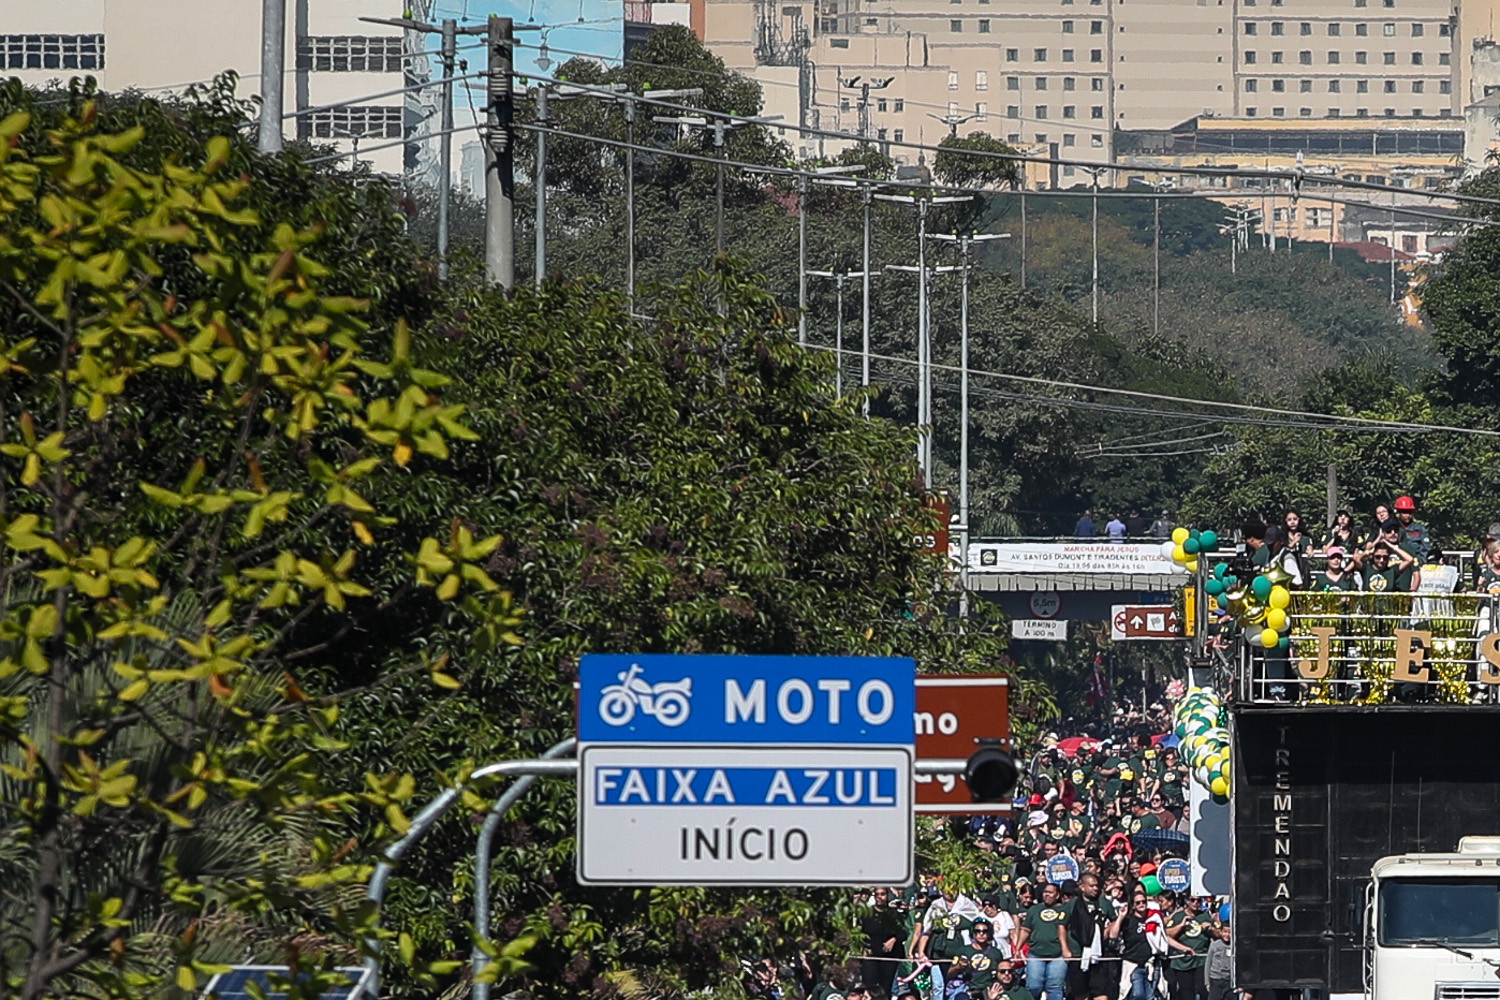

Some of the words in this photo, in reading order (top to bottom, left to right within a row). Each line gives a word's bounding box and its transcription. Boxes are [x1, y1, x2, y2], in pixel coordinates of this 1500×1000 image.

[724, 678, 895, 726] MOTO
[597, 769, 735, 803] FAIXA
[764, 769, 895, 804] AZUL
[679, 816, 810, 862] INÍCIO
